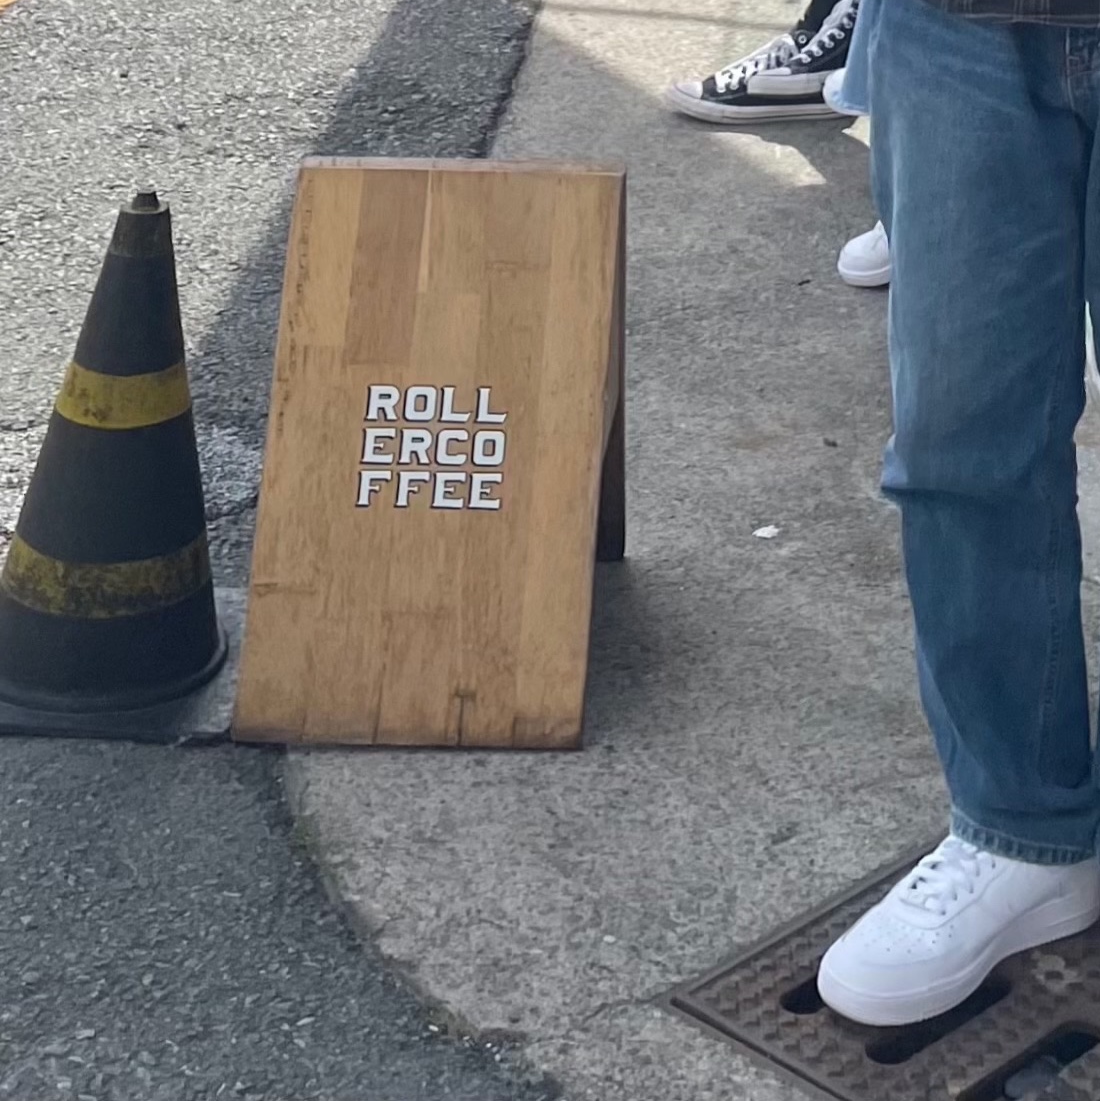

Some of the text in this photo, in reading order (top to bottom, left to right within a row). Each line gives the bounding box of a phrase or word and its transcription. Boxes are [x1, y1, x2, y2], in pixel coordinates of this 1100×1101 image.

[364, 385, 508, 423] ROLL
[360, 427, 506, 467] ERCO
[355, 470, 503, 510] FFEE
